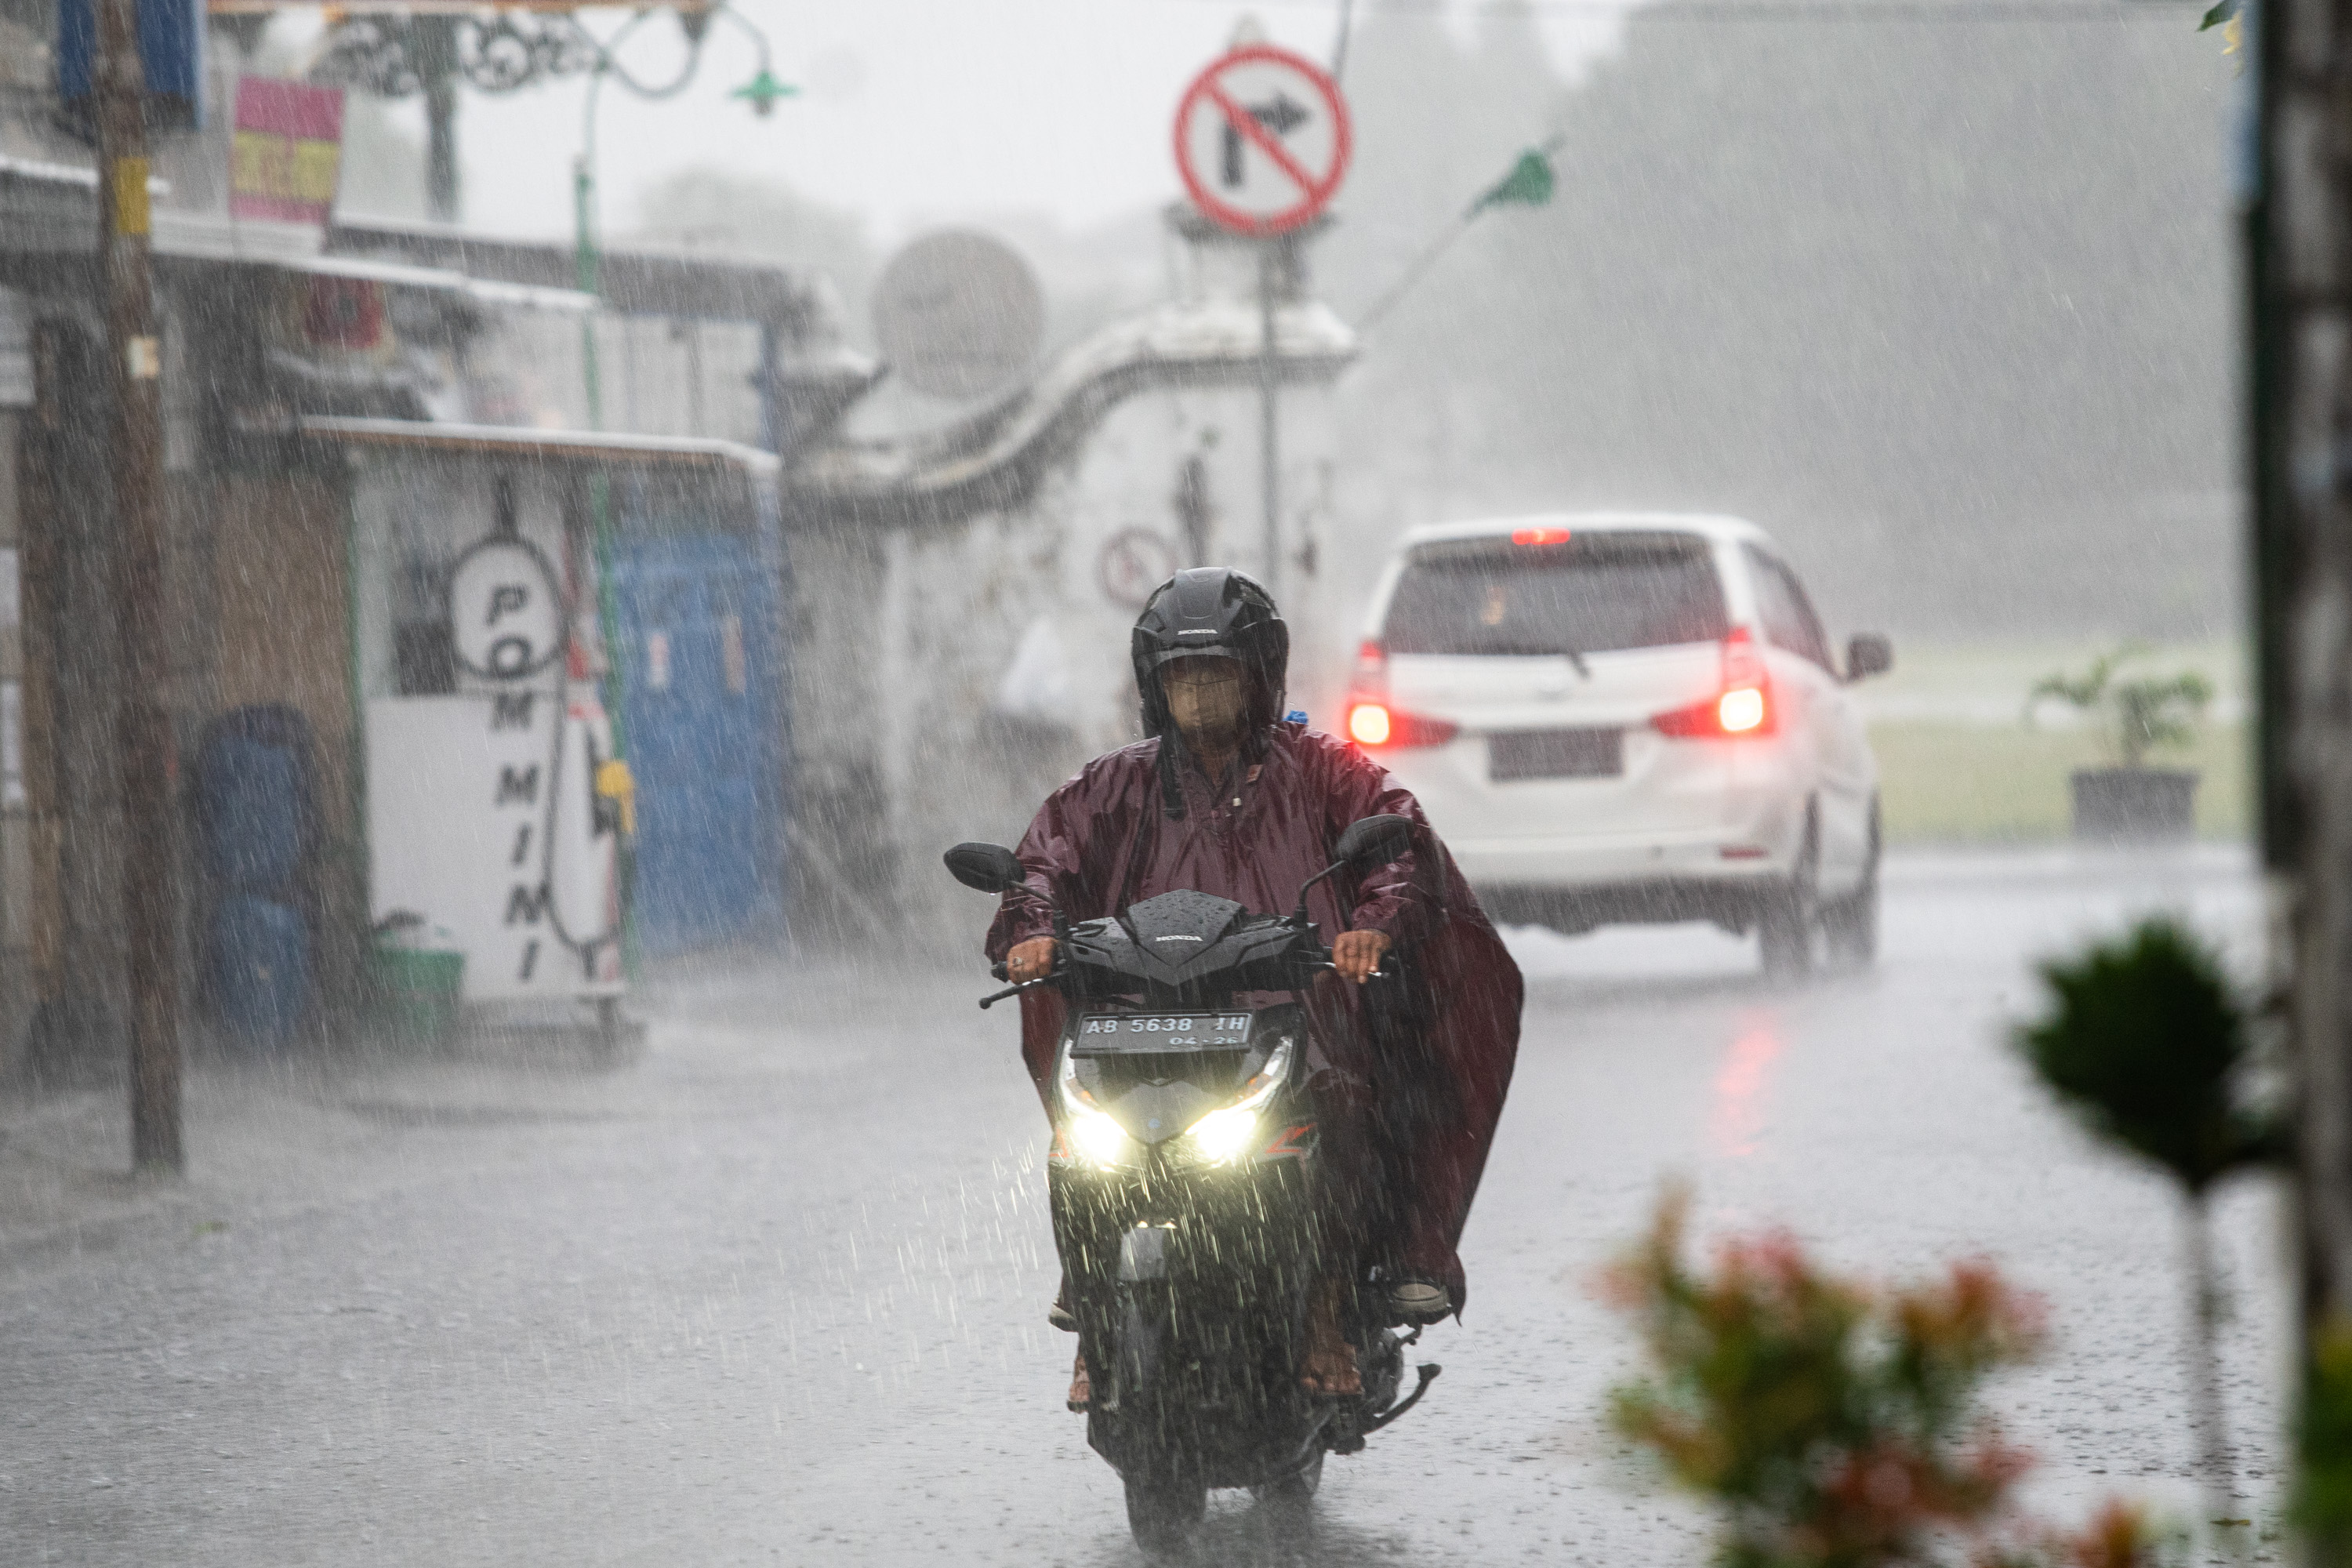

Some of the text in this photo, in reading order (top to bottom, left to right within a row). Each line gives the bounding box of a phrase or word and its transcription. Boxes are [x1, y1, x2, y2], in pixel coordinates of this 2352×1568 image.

[486, 583, 550, 982] POM MINI
[1086, 1019, 1119, 1034] AB
[1130, 1018, 1193, 1033] 5638
